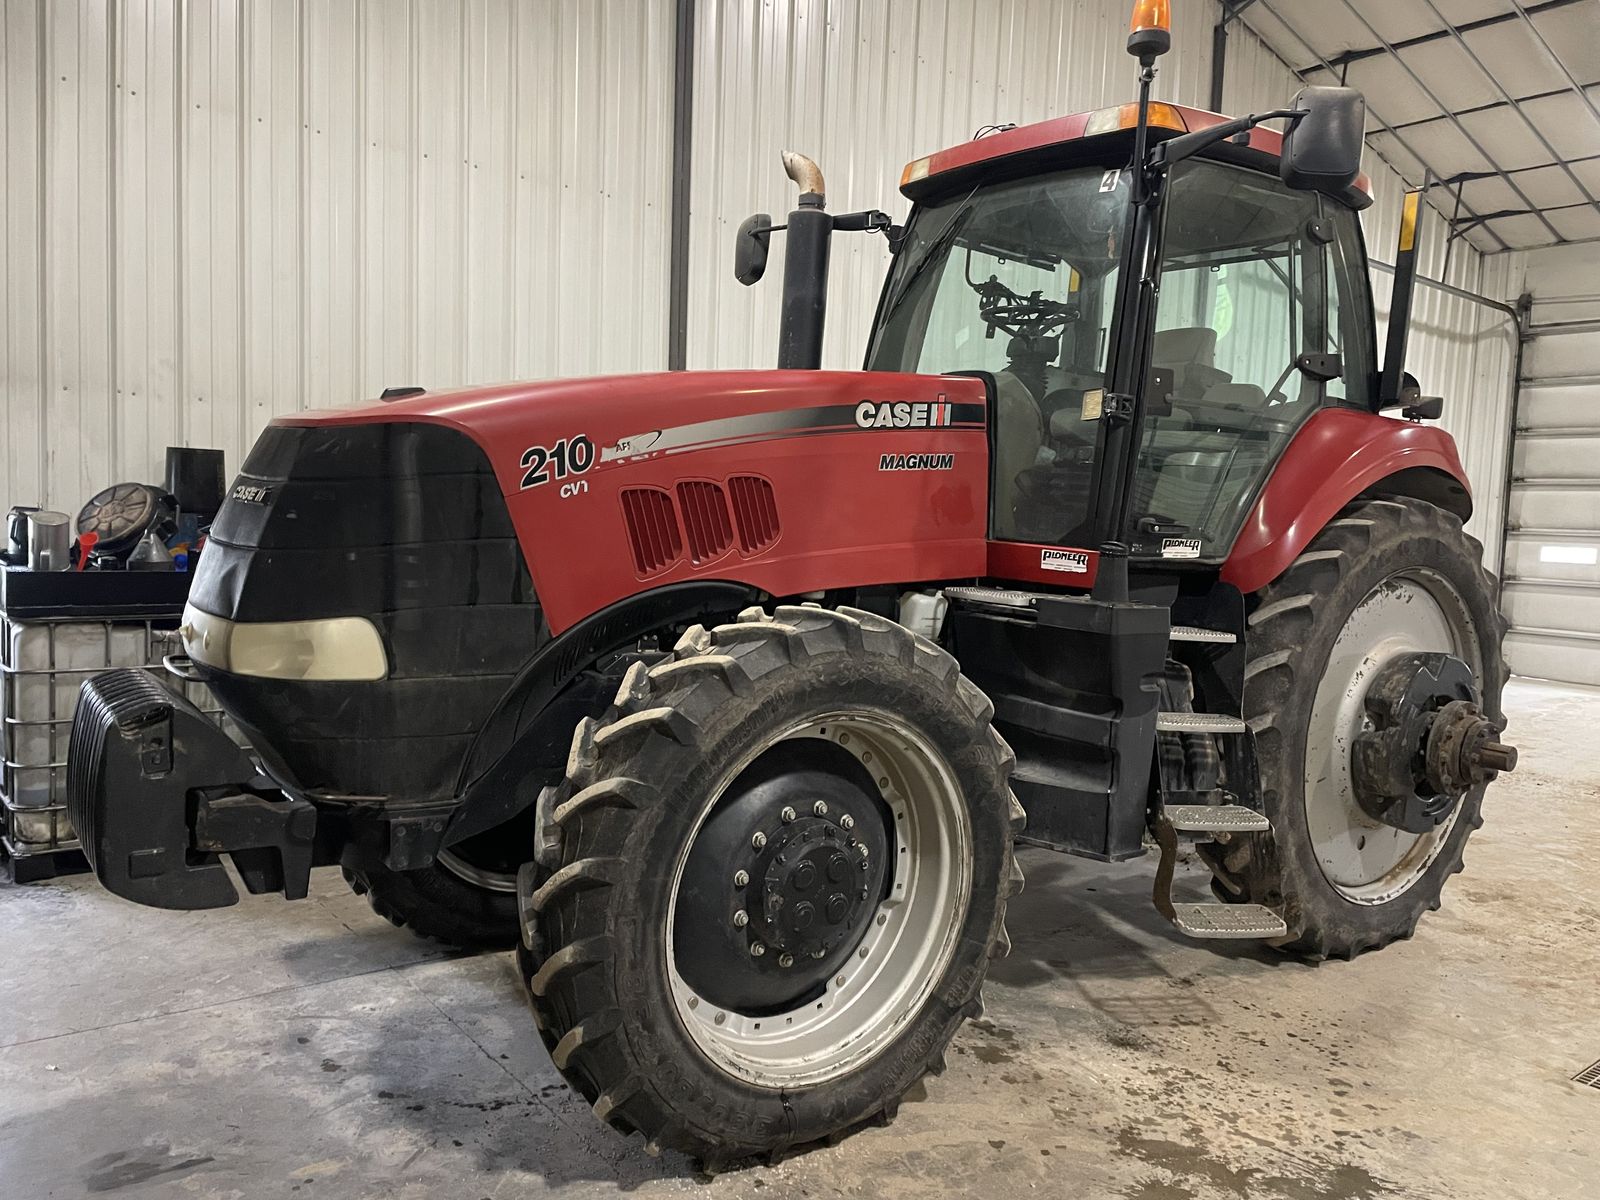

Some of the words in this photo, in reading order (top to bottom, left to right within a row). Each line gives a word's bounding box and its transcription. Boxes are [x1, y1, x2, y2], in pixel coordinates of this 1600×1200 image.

[1101, 170, 1117, 191] 4
[855, 402, 928, 428] CASE
[520, 434, 595, 490] 210
[879, 454, 954, 471] MAGNUM
[1163, 539, 1200, 551] PIONEER
[1043, 551, 1087, 565] PIONEER
